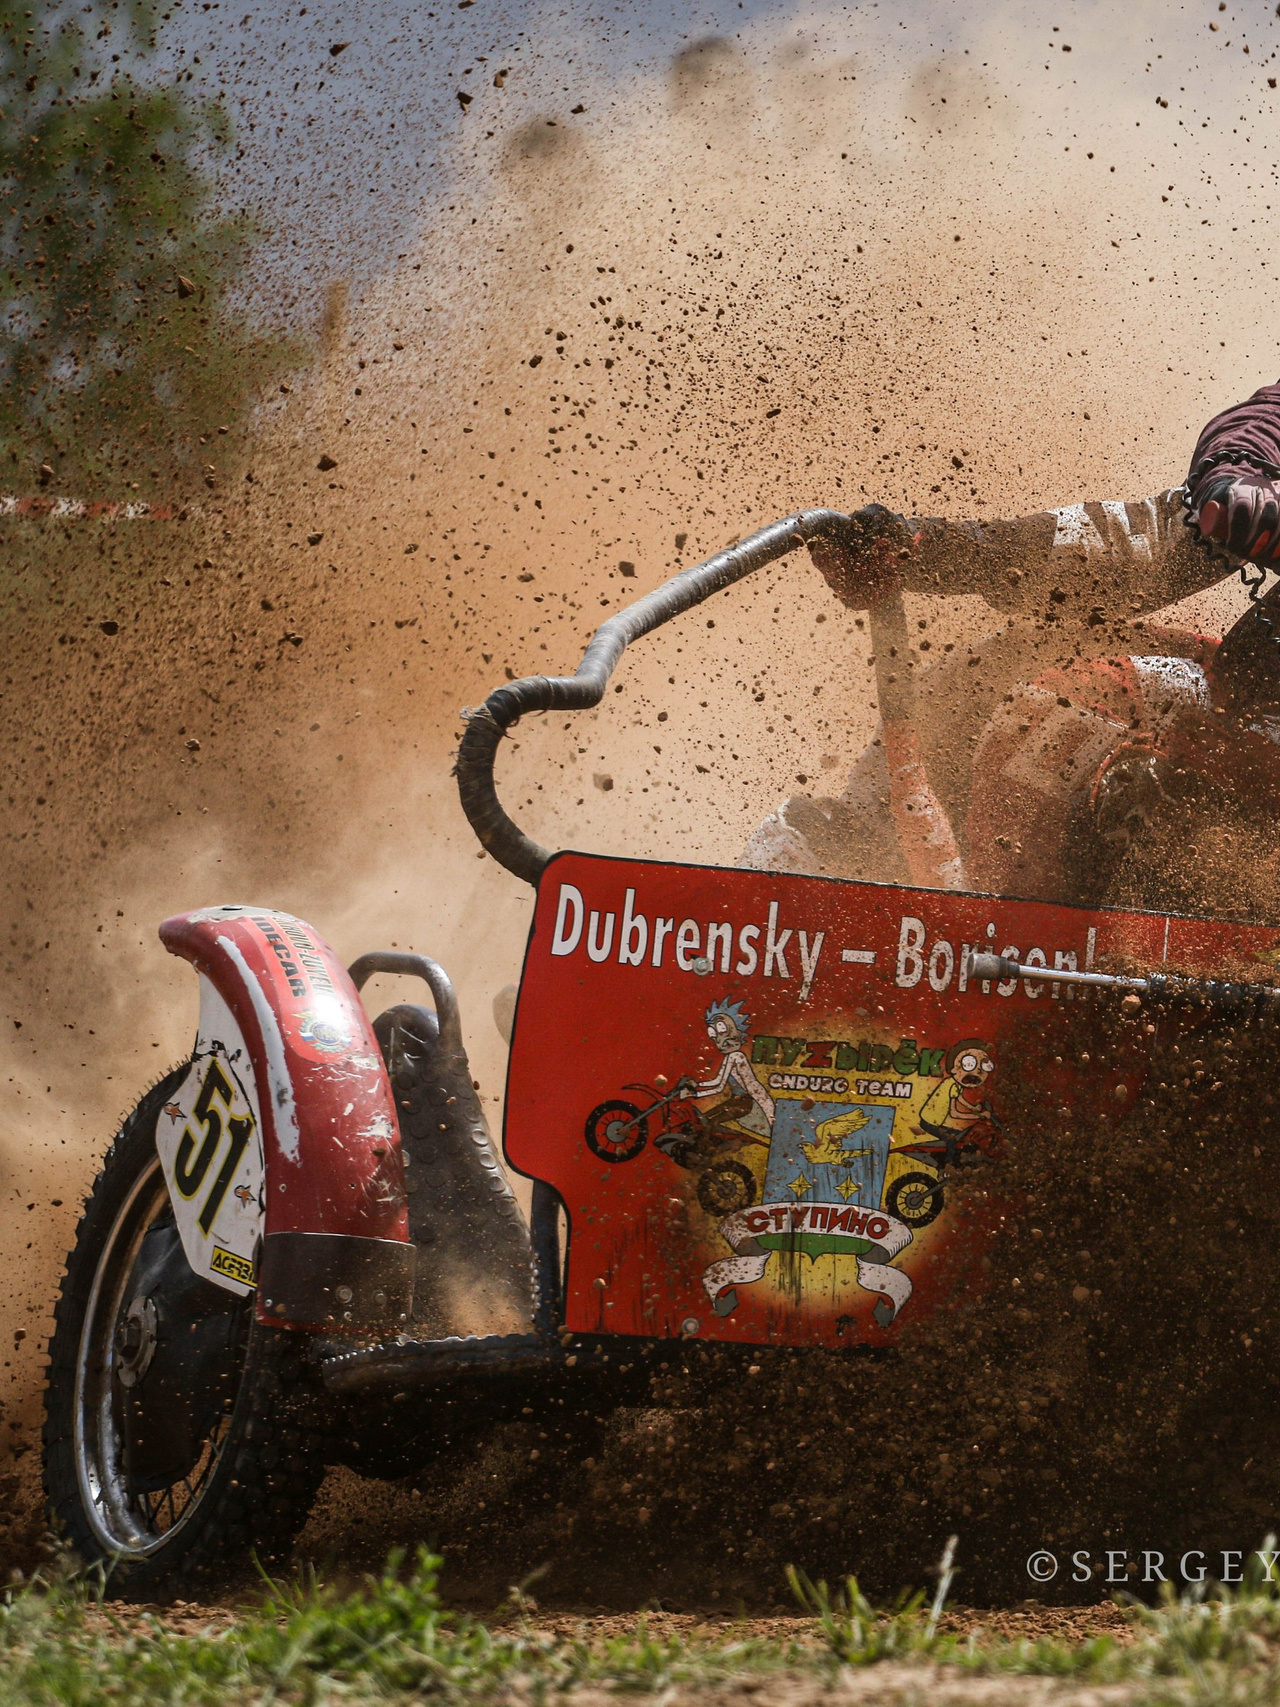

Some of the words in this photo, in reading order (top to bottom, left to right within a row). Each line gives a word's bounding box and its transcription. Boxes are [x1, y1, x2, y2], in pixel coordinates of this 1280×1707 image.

[551, 883, 825, 1001] Dubrensky
[173, 1056, 256, 1241] 51
[746, 1205, 890, 1240] СТУПИНО
